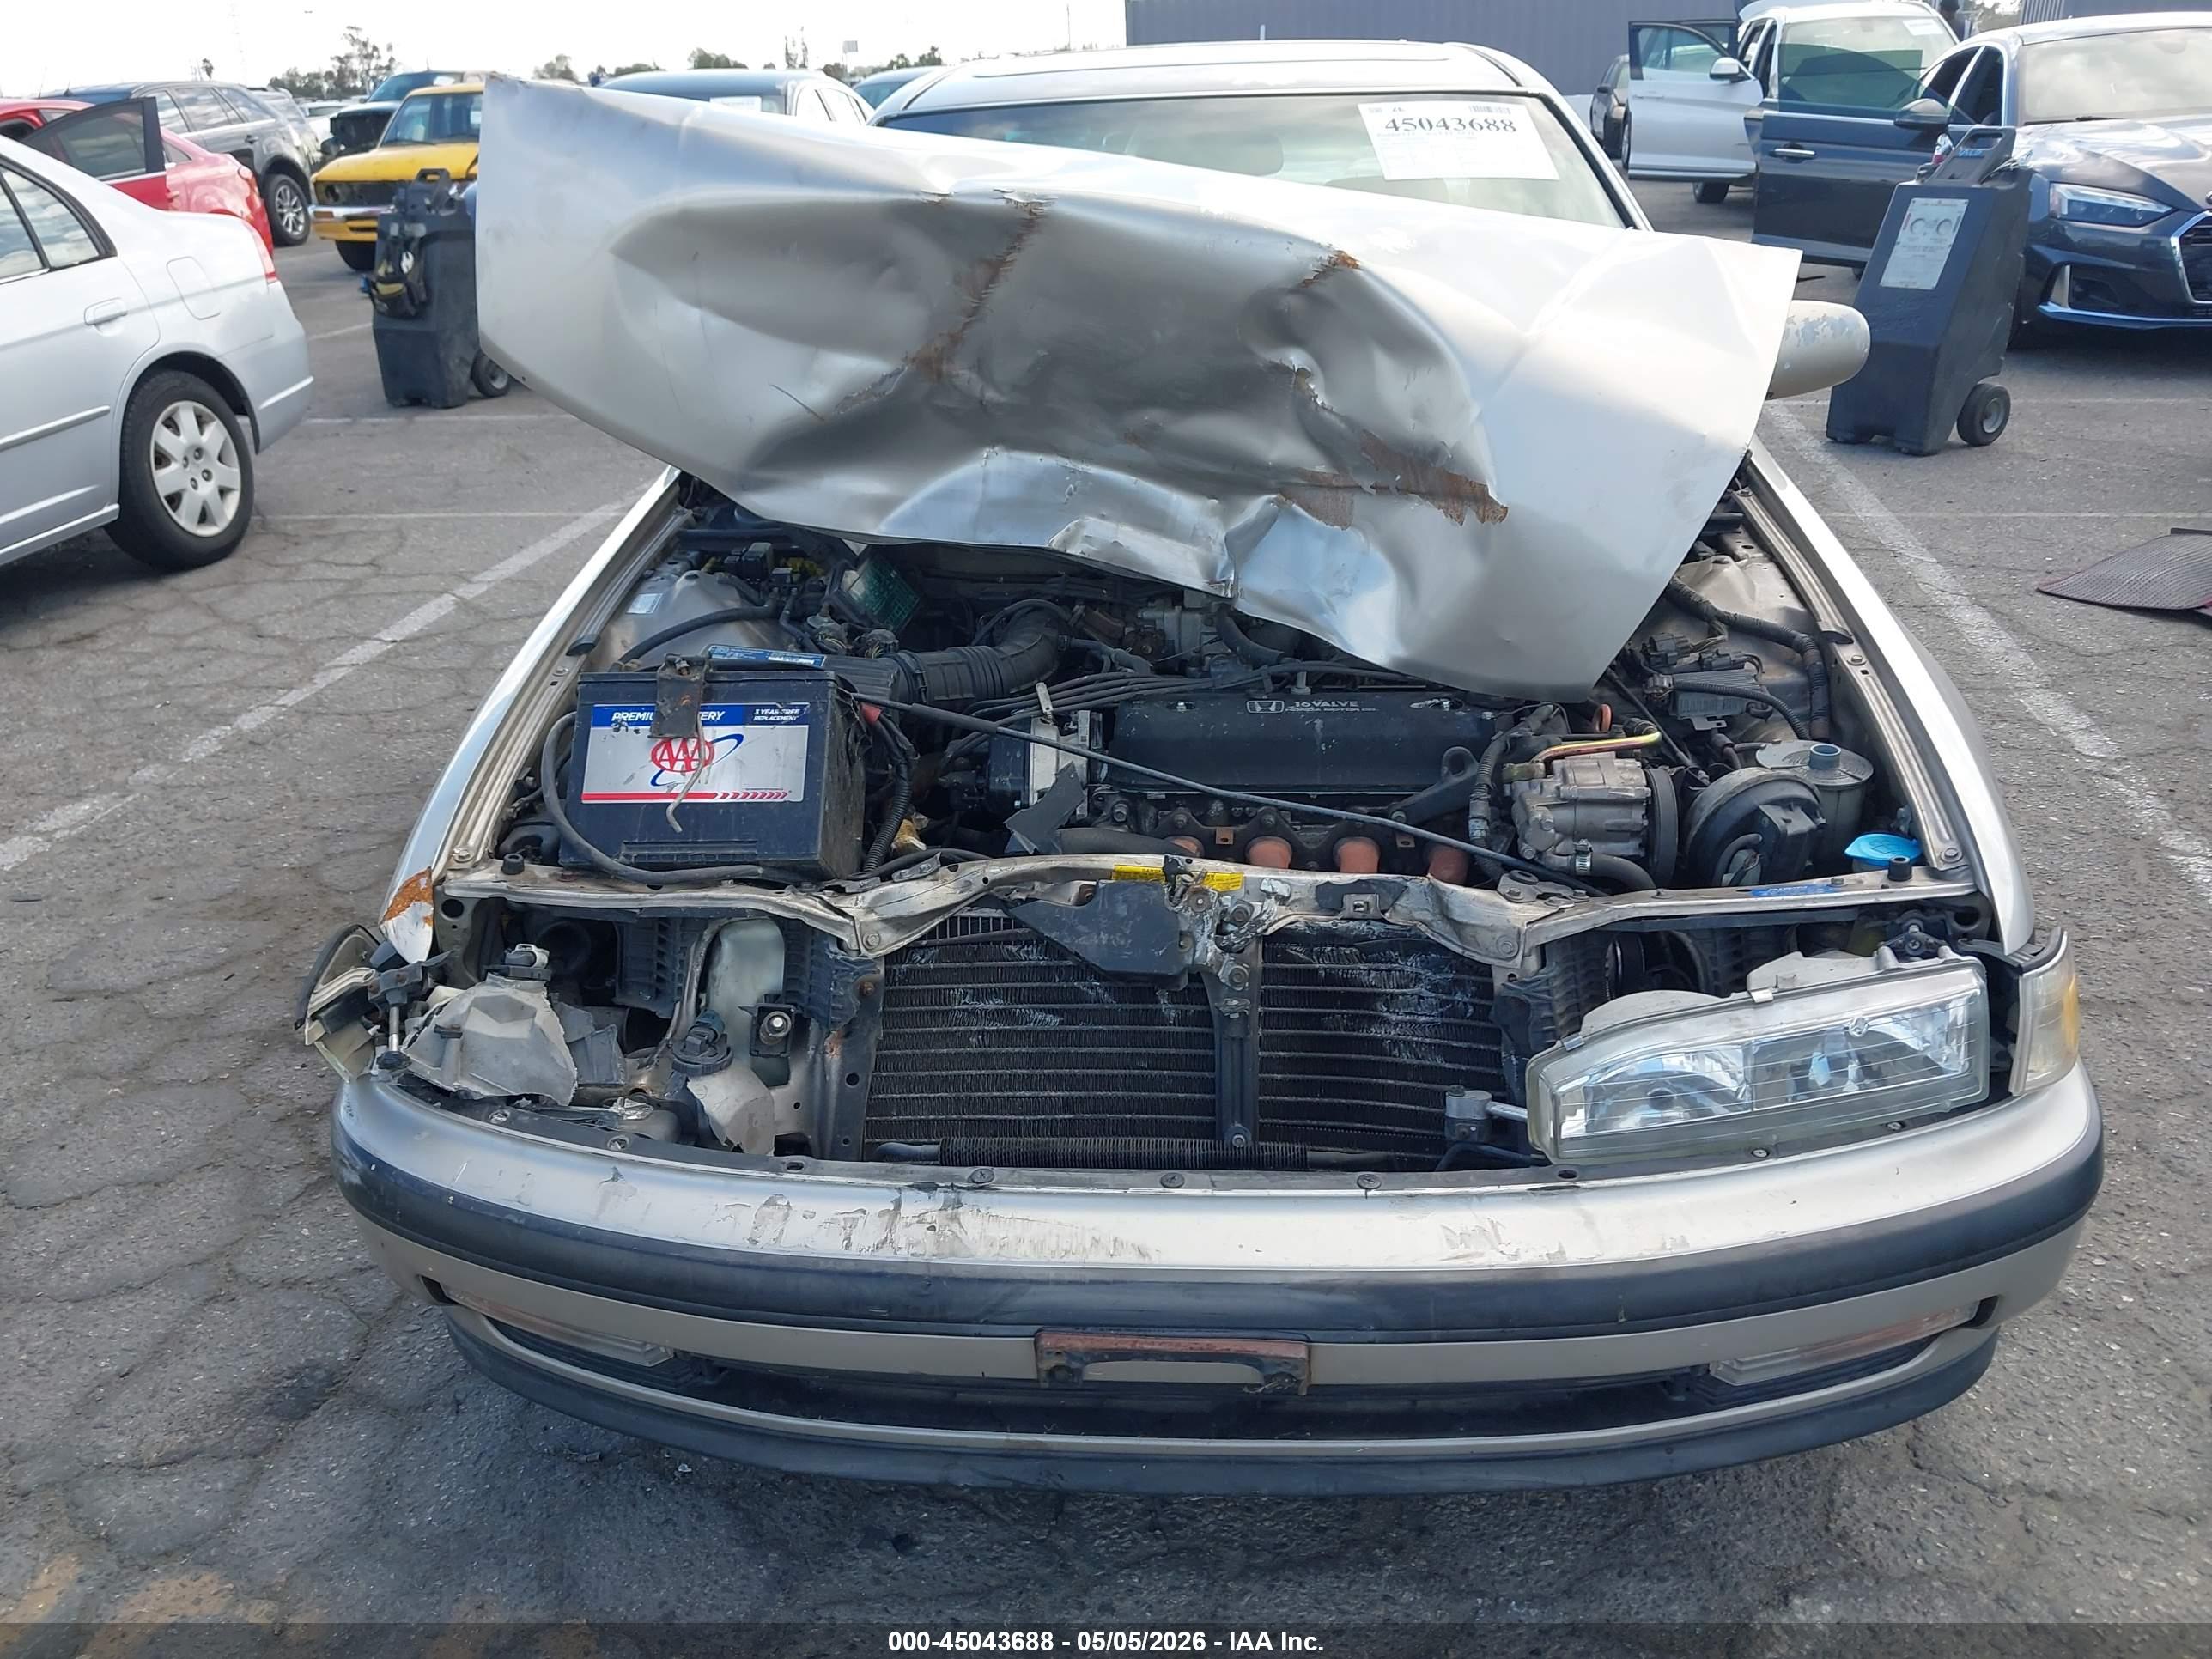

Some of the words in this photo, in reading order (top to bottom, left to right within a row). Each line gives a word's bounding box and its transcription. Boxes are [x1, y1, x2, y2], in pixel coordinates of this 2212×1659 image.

[1385, 117, 1517, 132] 45043688
[611, 711, 653, 722] PREMI
[654, 738, 709, 772] AAA
